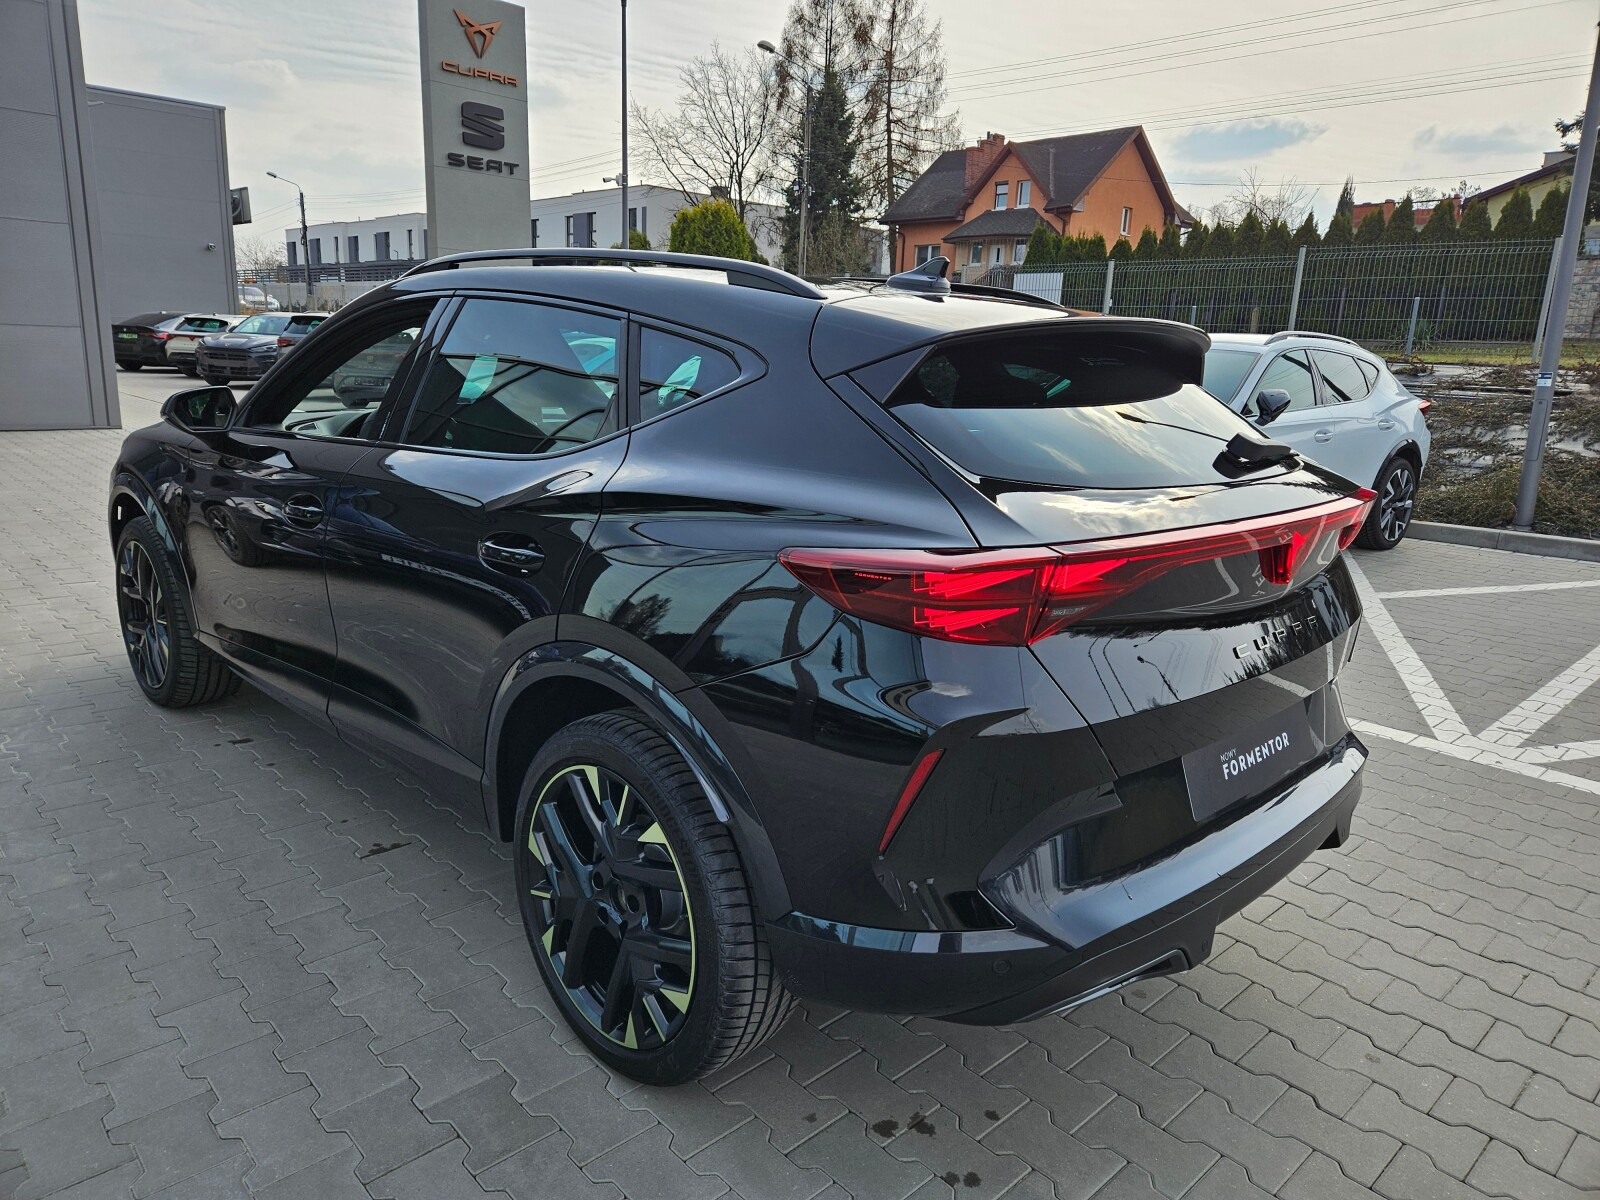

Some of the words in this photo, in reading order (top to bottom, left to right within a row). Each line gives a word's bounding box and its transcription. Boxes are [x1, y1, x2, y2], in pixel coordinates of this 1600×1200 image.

[442, 60, 520, 88] CUPRA
[447, 152, 520, 176] SEAT
[1220, 748, 1238, 763] NOWY
[1222, 732, 1290, 780] FORMENTOR
